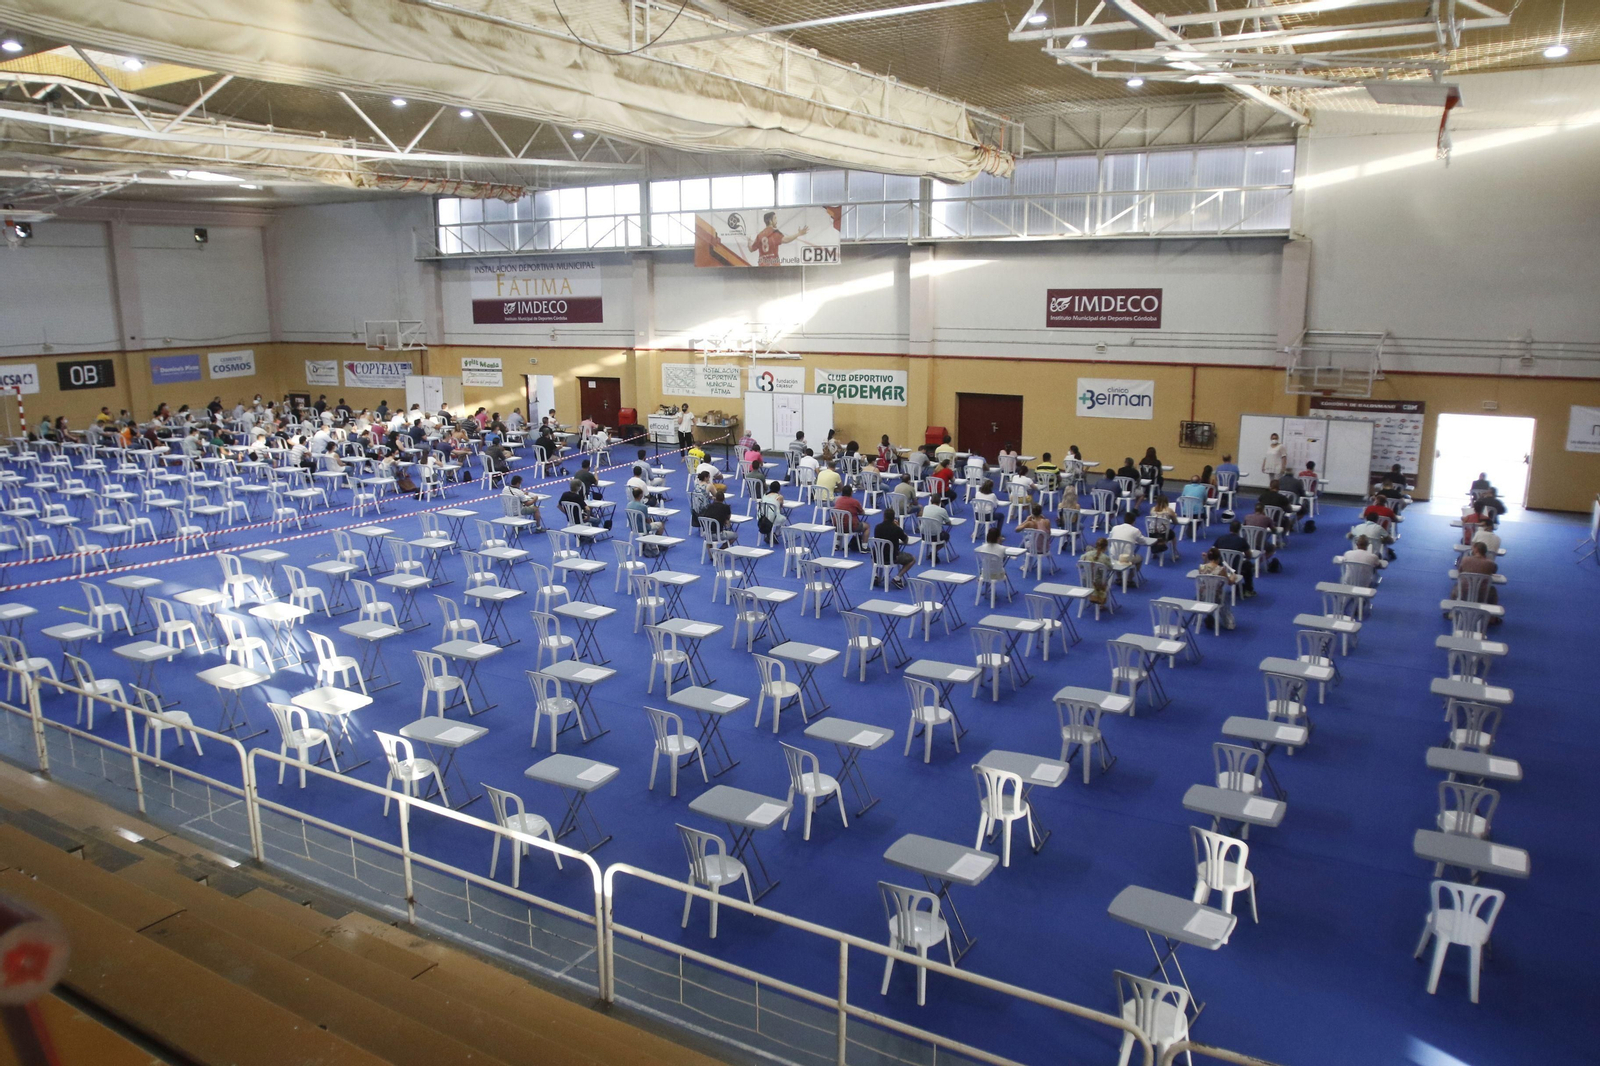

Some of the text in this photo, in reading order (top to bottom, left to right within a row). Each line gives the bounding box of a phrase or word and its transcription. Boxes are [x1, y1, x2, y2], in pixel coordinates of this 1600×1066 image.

[762, 237, 769, 253] 8
[803, 247, 837, 262] CBM
[474, 261, 596, 274] INSTALACIÓN DEPORTIVA MUNICIPAL
[496, 273, 573, 297] FÁTIMA
[517, 300, 568, 314] IMDECO
[1074, 295, 1159, 312] IMDECO
[212, 362, 252, 373] COSMOS
[355, 362, 400, 375] COPYFAX
[69, 365, 99, 386] OB
[827, 373, 894, 383] CLUB DEPORTIVO
[816, 383, 906, 402] APADEMAR
[1086, 389, 1152, 410] Beiman
